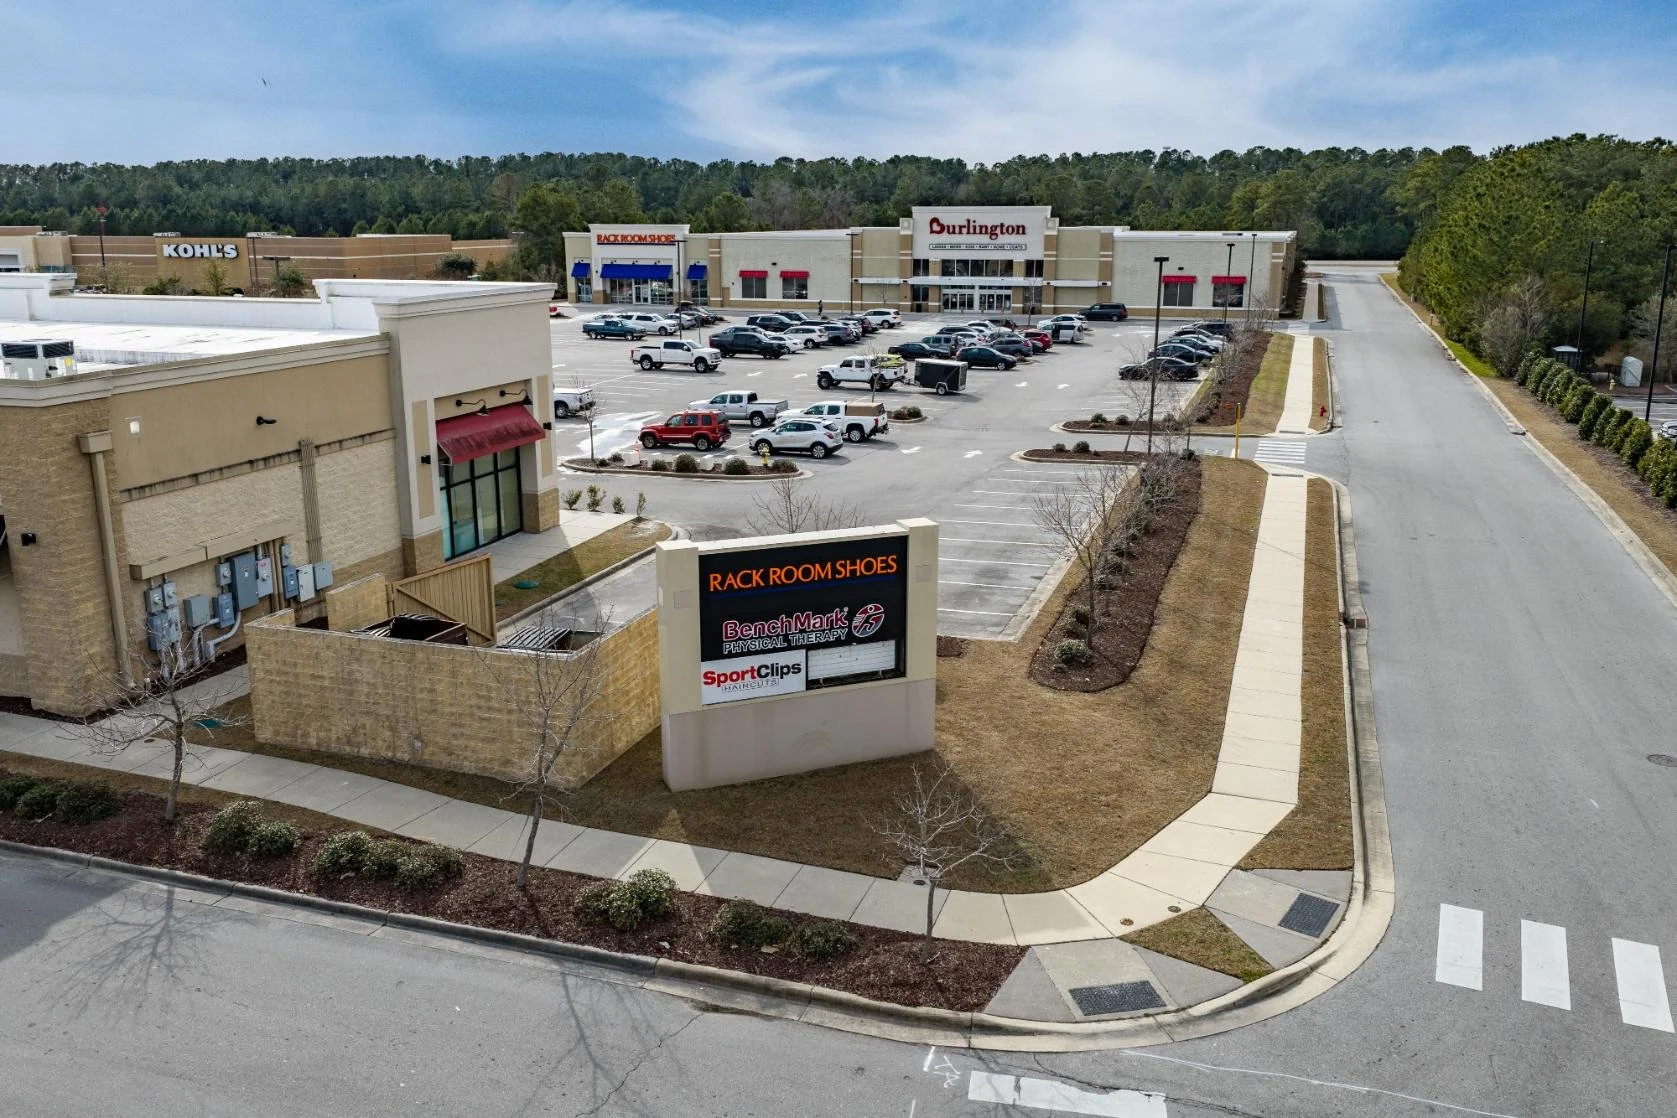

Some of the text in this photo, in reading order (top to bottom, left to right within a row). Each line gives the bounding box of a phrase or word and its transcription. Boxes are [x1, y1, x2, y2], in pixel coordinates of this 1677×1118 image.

[929, 217, 1026, 240] Burlington
[163, 244, 239, 258] KOHL'S
[709, 555, 897, 592] RACK ROOM SHOES
[723, 628, 848, 654] PHYSICAL THERAPY
